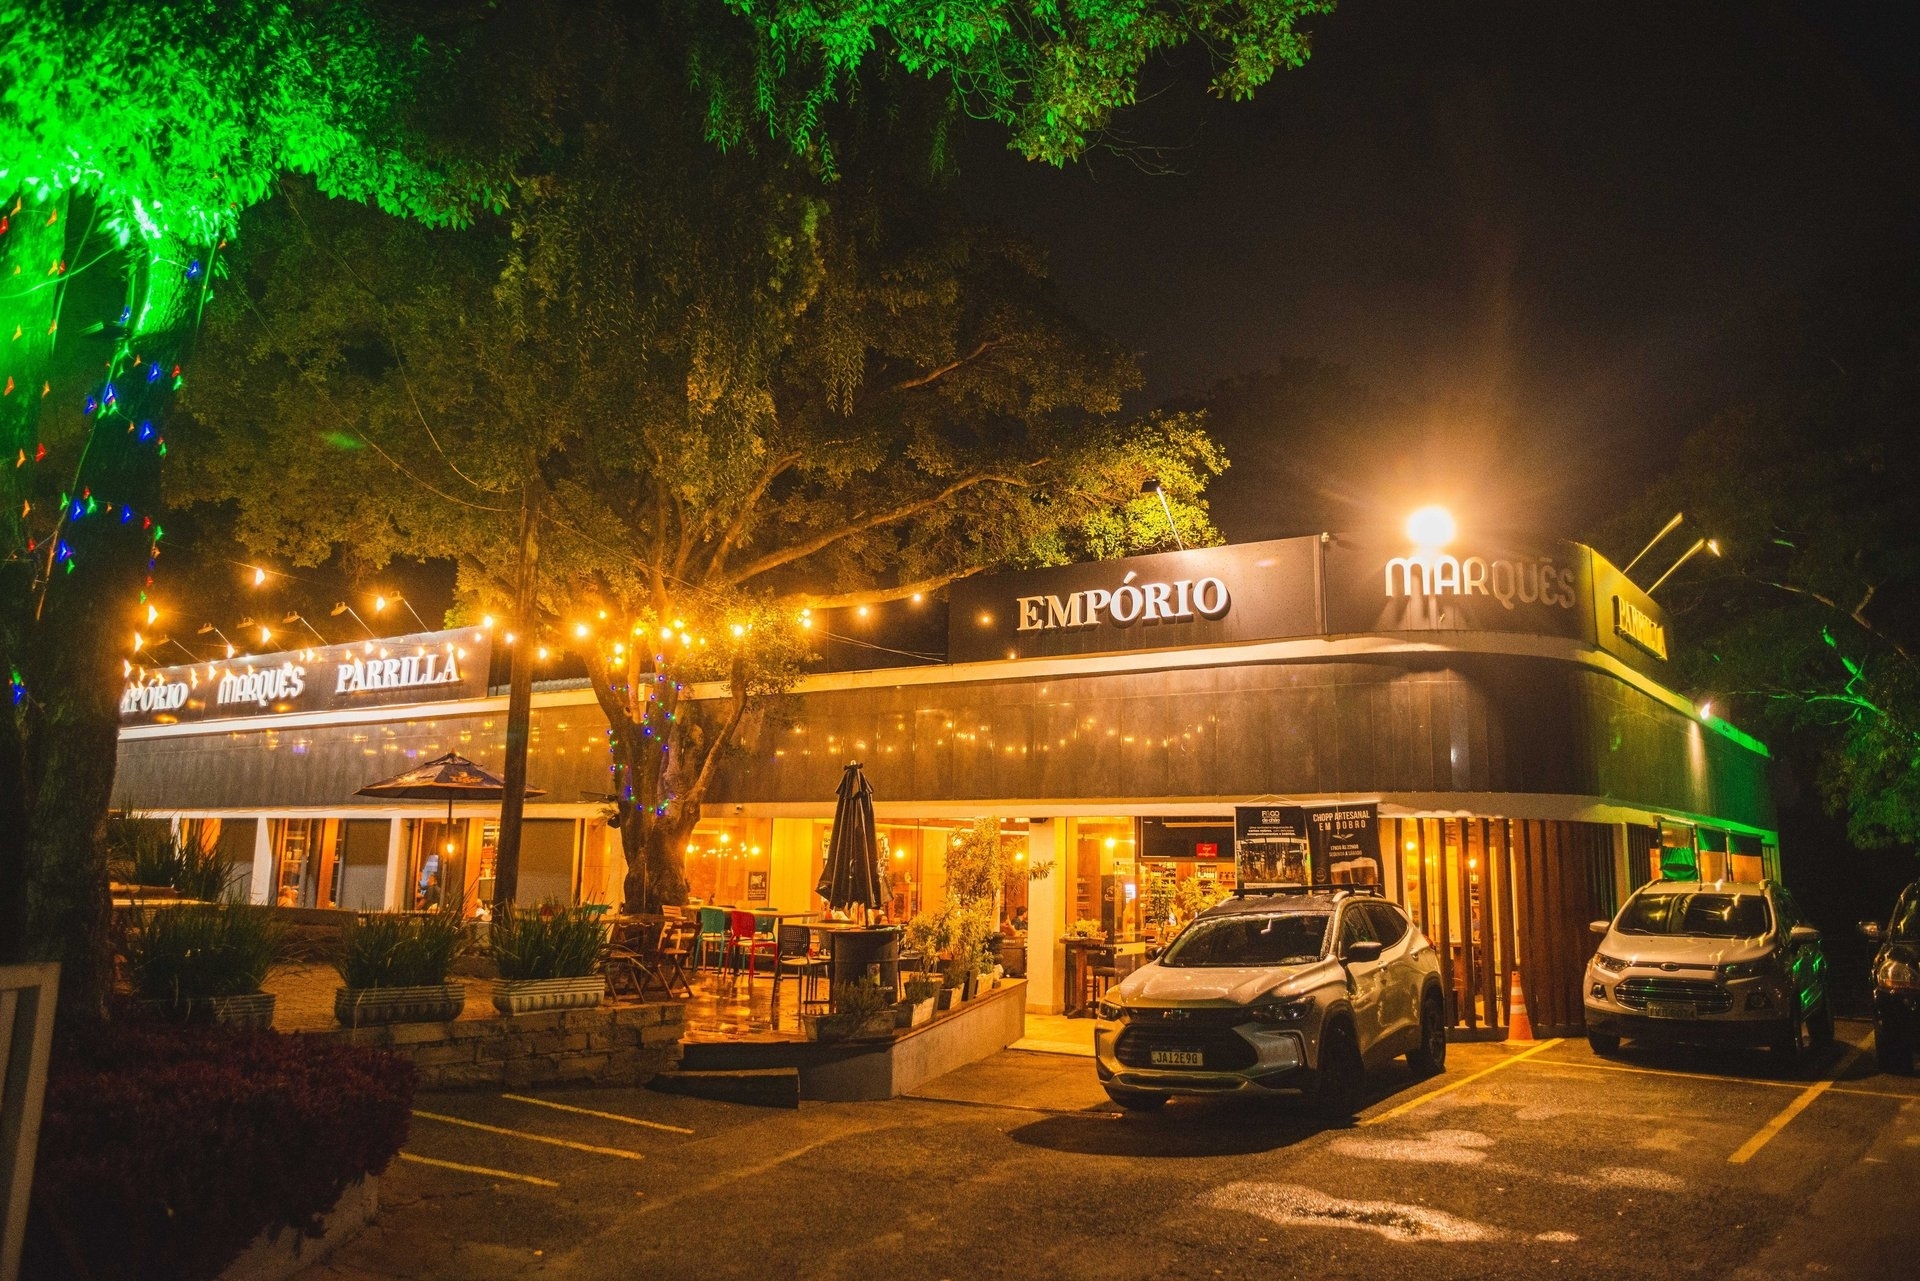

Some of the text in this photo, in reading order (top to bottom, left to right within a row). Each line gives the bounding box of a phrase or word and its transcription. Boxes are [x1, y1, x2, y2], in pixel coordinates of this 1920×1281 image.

[1016, 571, 1228, 631] EMPÓRIO
[1385, 555, 1576, 610] MARQUÊS
[217, 663, 306, 708] MARQUÊS
[335, 653, 461, 694] PARRILLA
[1312, 810, 1370, 823] CHOPP ARTESANAL
[1319, 820, 1366, 832] EM DOBRO
